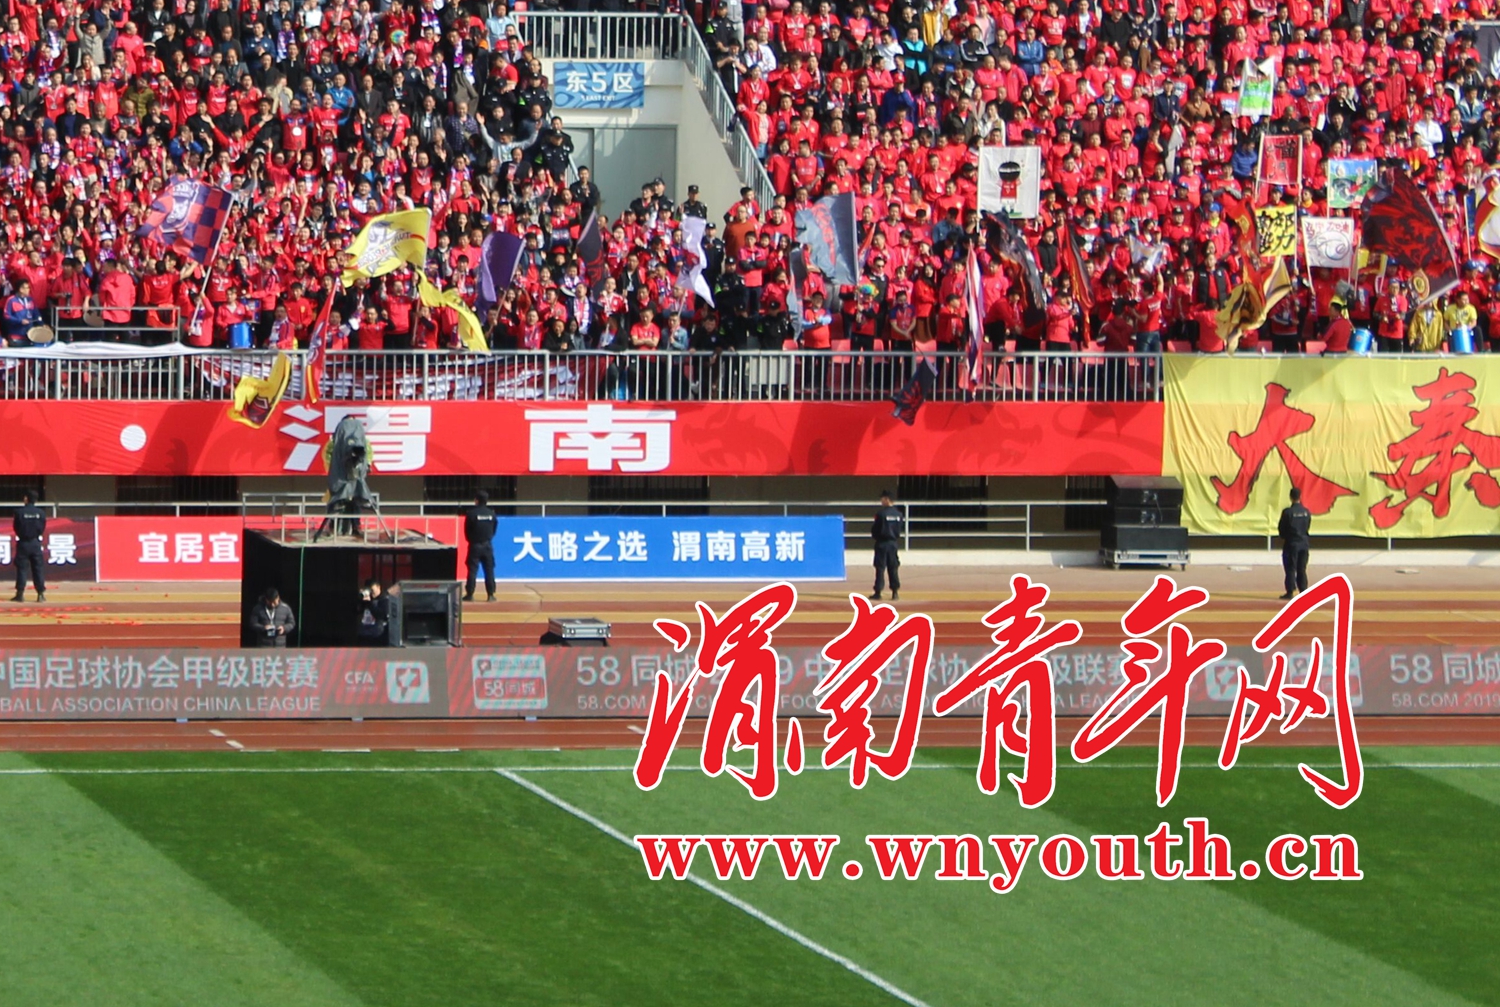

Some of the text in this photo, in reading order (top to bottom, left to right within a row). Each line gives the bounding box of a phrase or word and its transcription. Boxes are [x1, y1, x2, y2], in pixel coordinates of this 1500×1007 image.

[565, 71, 634, 93] 东5区
[138, 531, 240, 563] 宜居宜
[513, 530, 806, 562] 大略之选 渭南高新
[344, 671, 374, 684] CFA
[576, 656, 621, 687] 58
[1391, 655, 1433, 685] 58
[50, 697, 179, 712] ASSOCIATION
[183, 696, 241, 711] CHINA
[246, 696, 321, 711] LEAGUE
[577, 695, 647, 710] 58.COM
[1392, 694, 1458, 708] 58.COM
